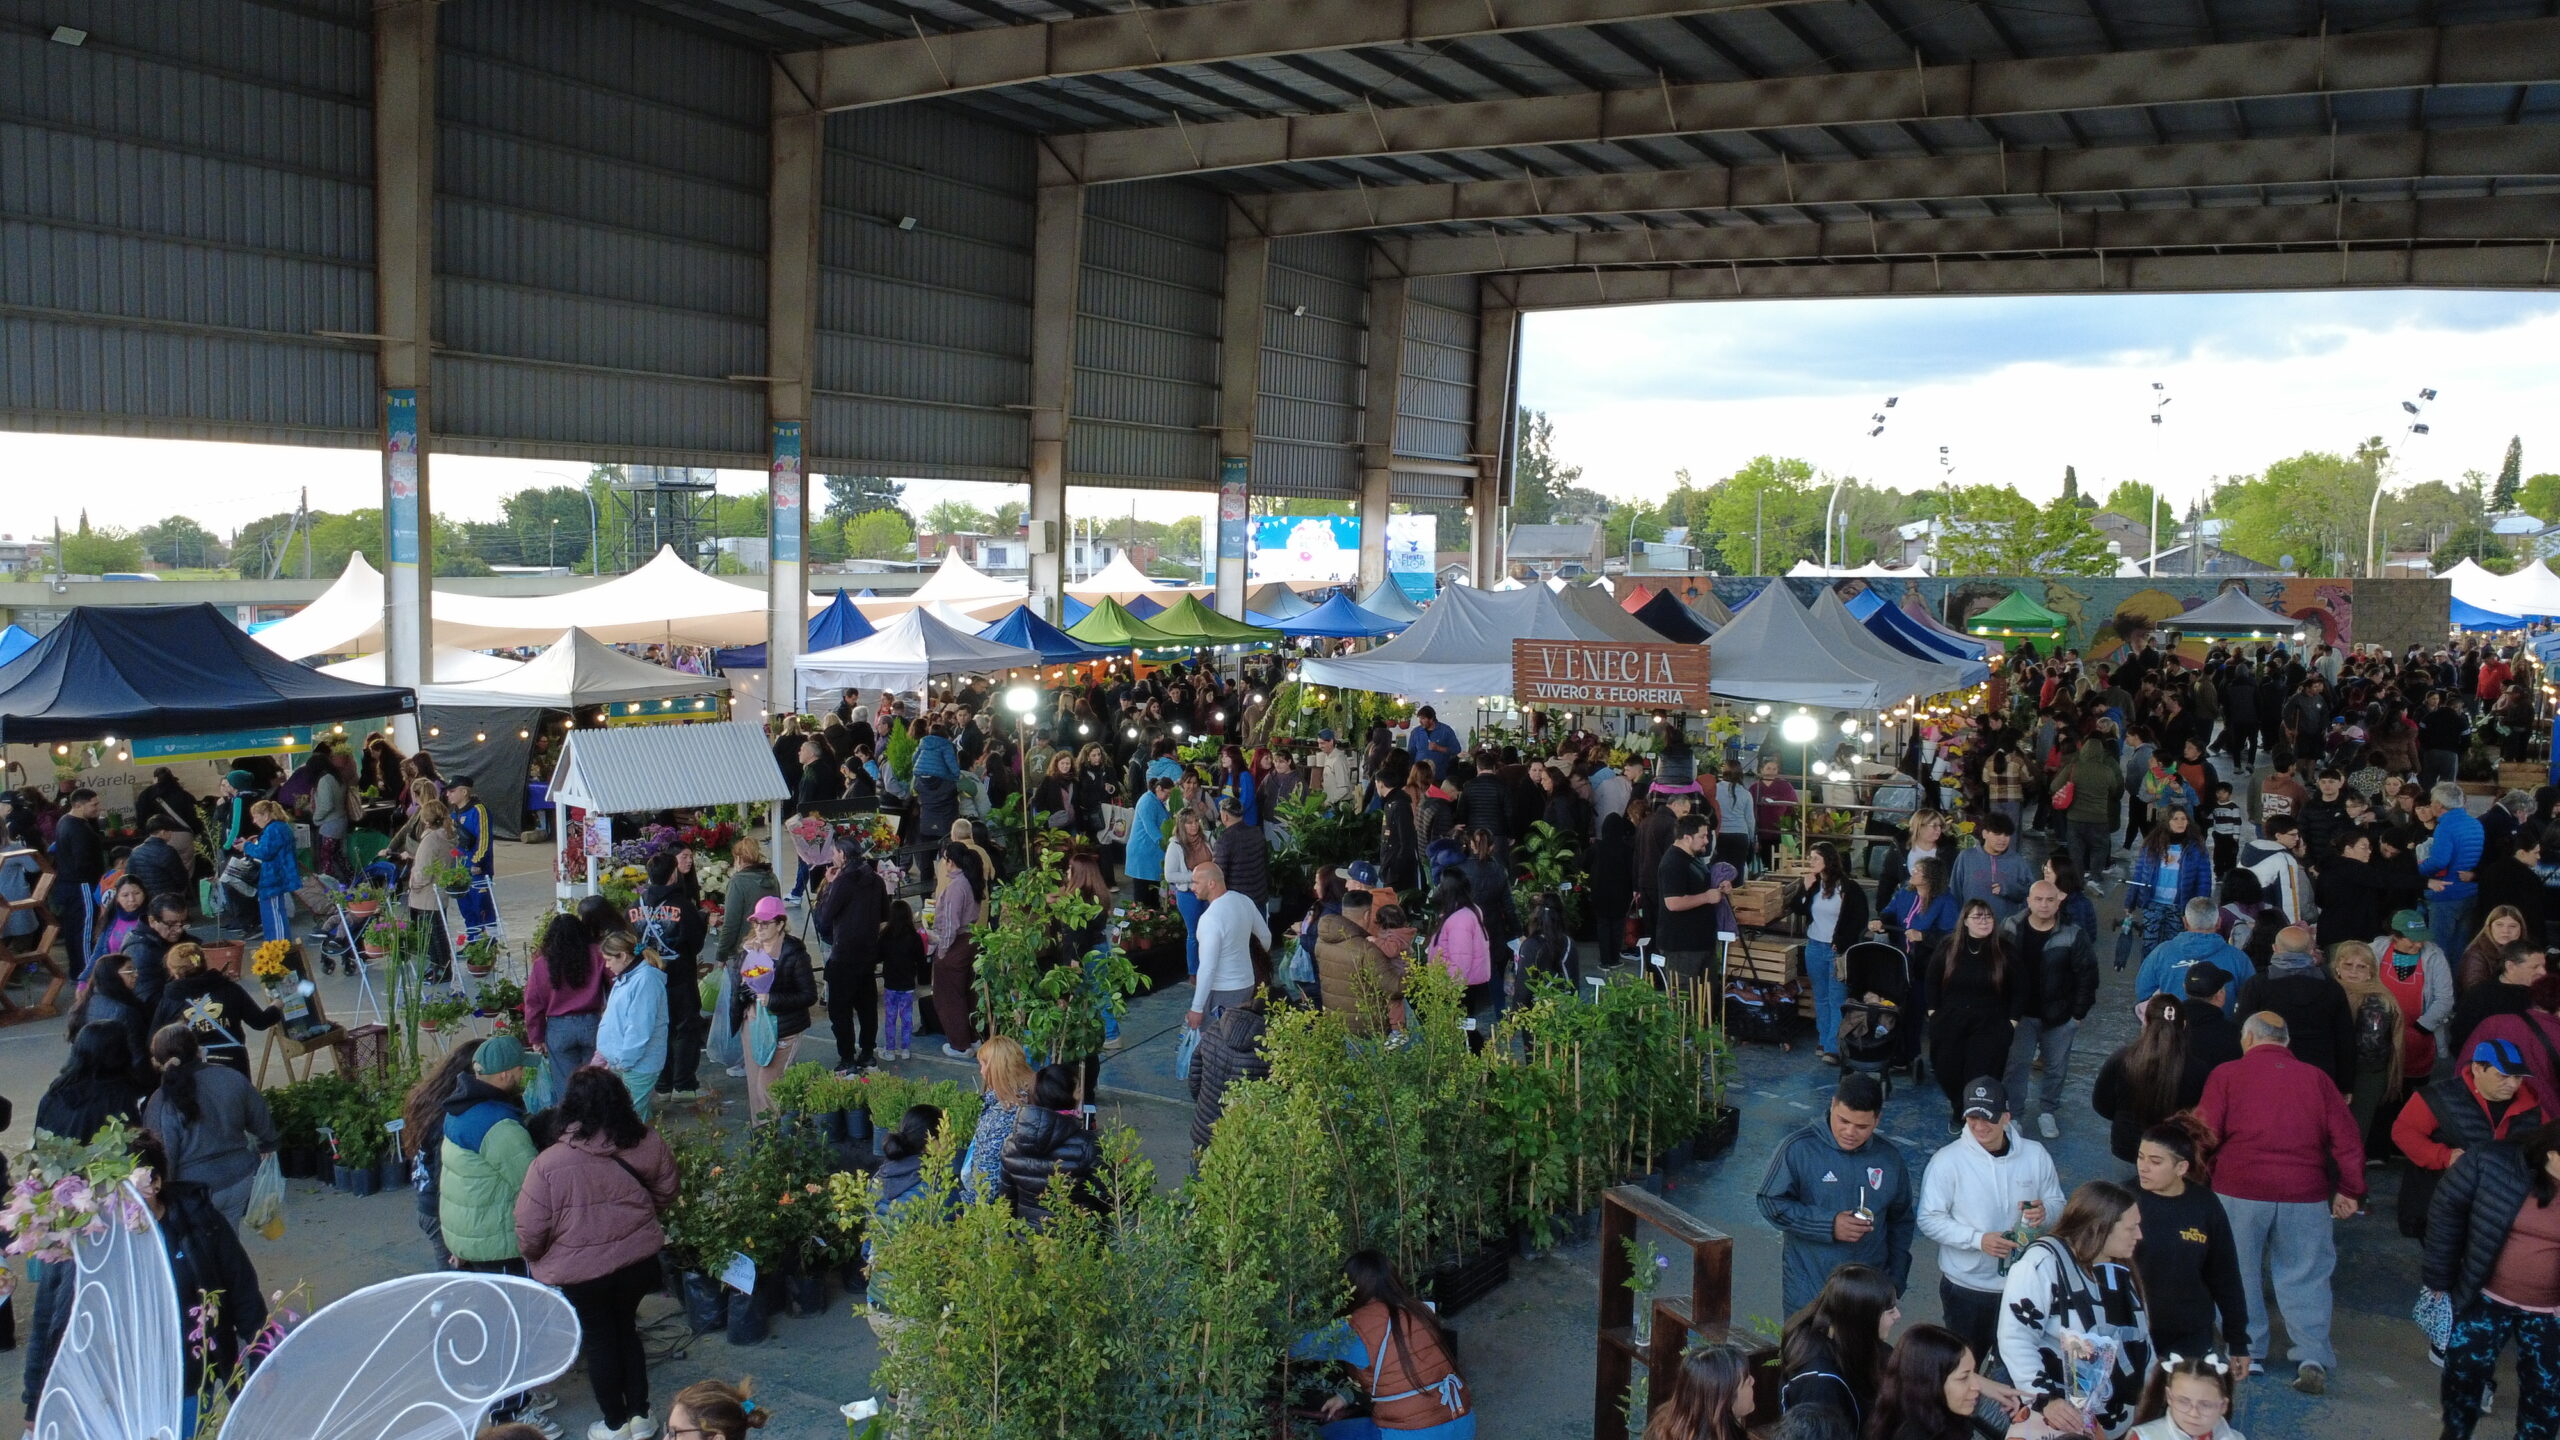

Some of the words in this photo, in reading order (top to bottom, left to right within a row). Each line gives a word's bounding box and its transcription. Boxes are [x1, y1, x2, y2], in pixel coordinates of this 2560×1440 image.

[1401, 553, 1424, 561] Fiesta
[1401, 559, 1425, 569] FLOR
[1541, 647, 1675, 685] VENECIA
[1536, 682, 1590, 700] VIVERO
[1594, 687, 1605, 701] &
[1610, 686, 1684, 705] FLORERIA
[86, 772, 136, 789] Varela
